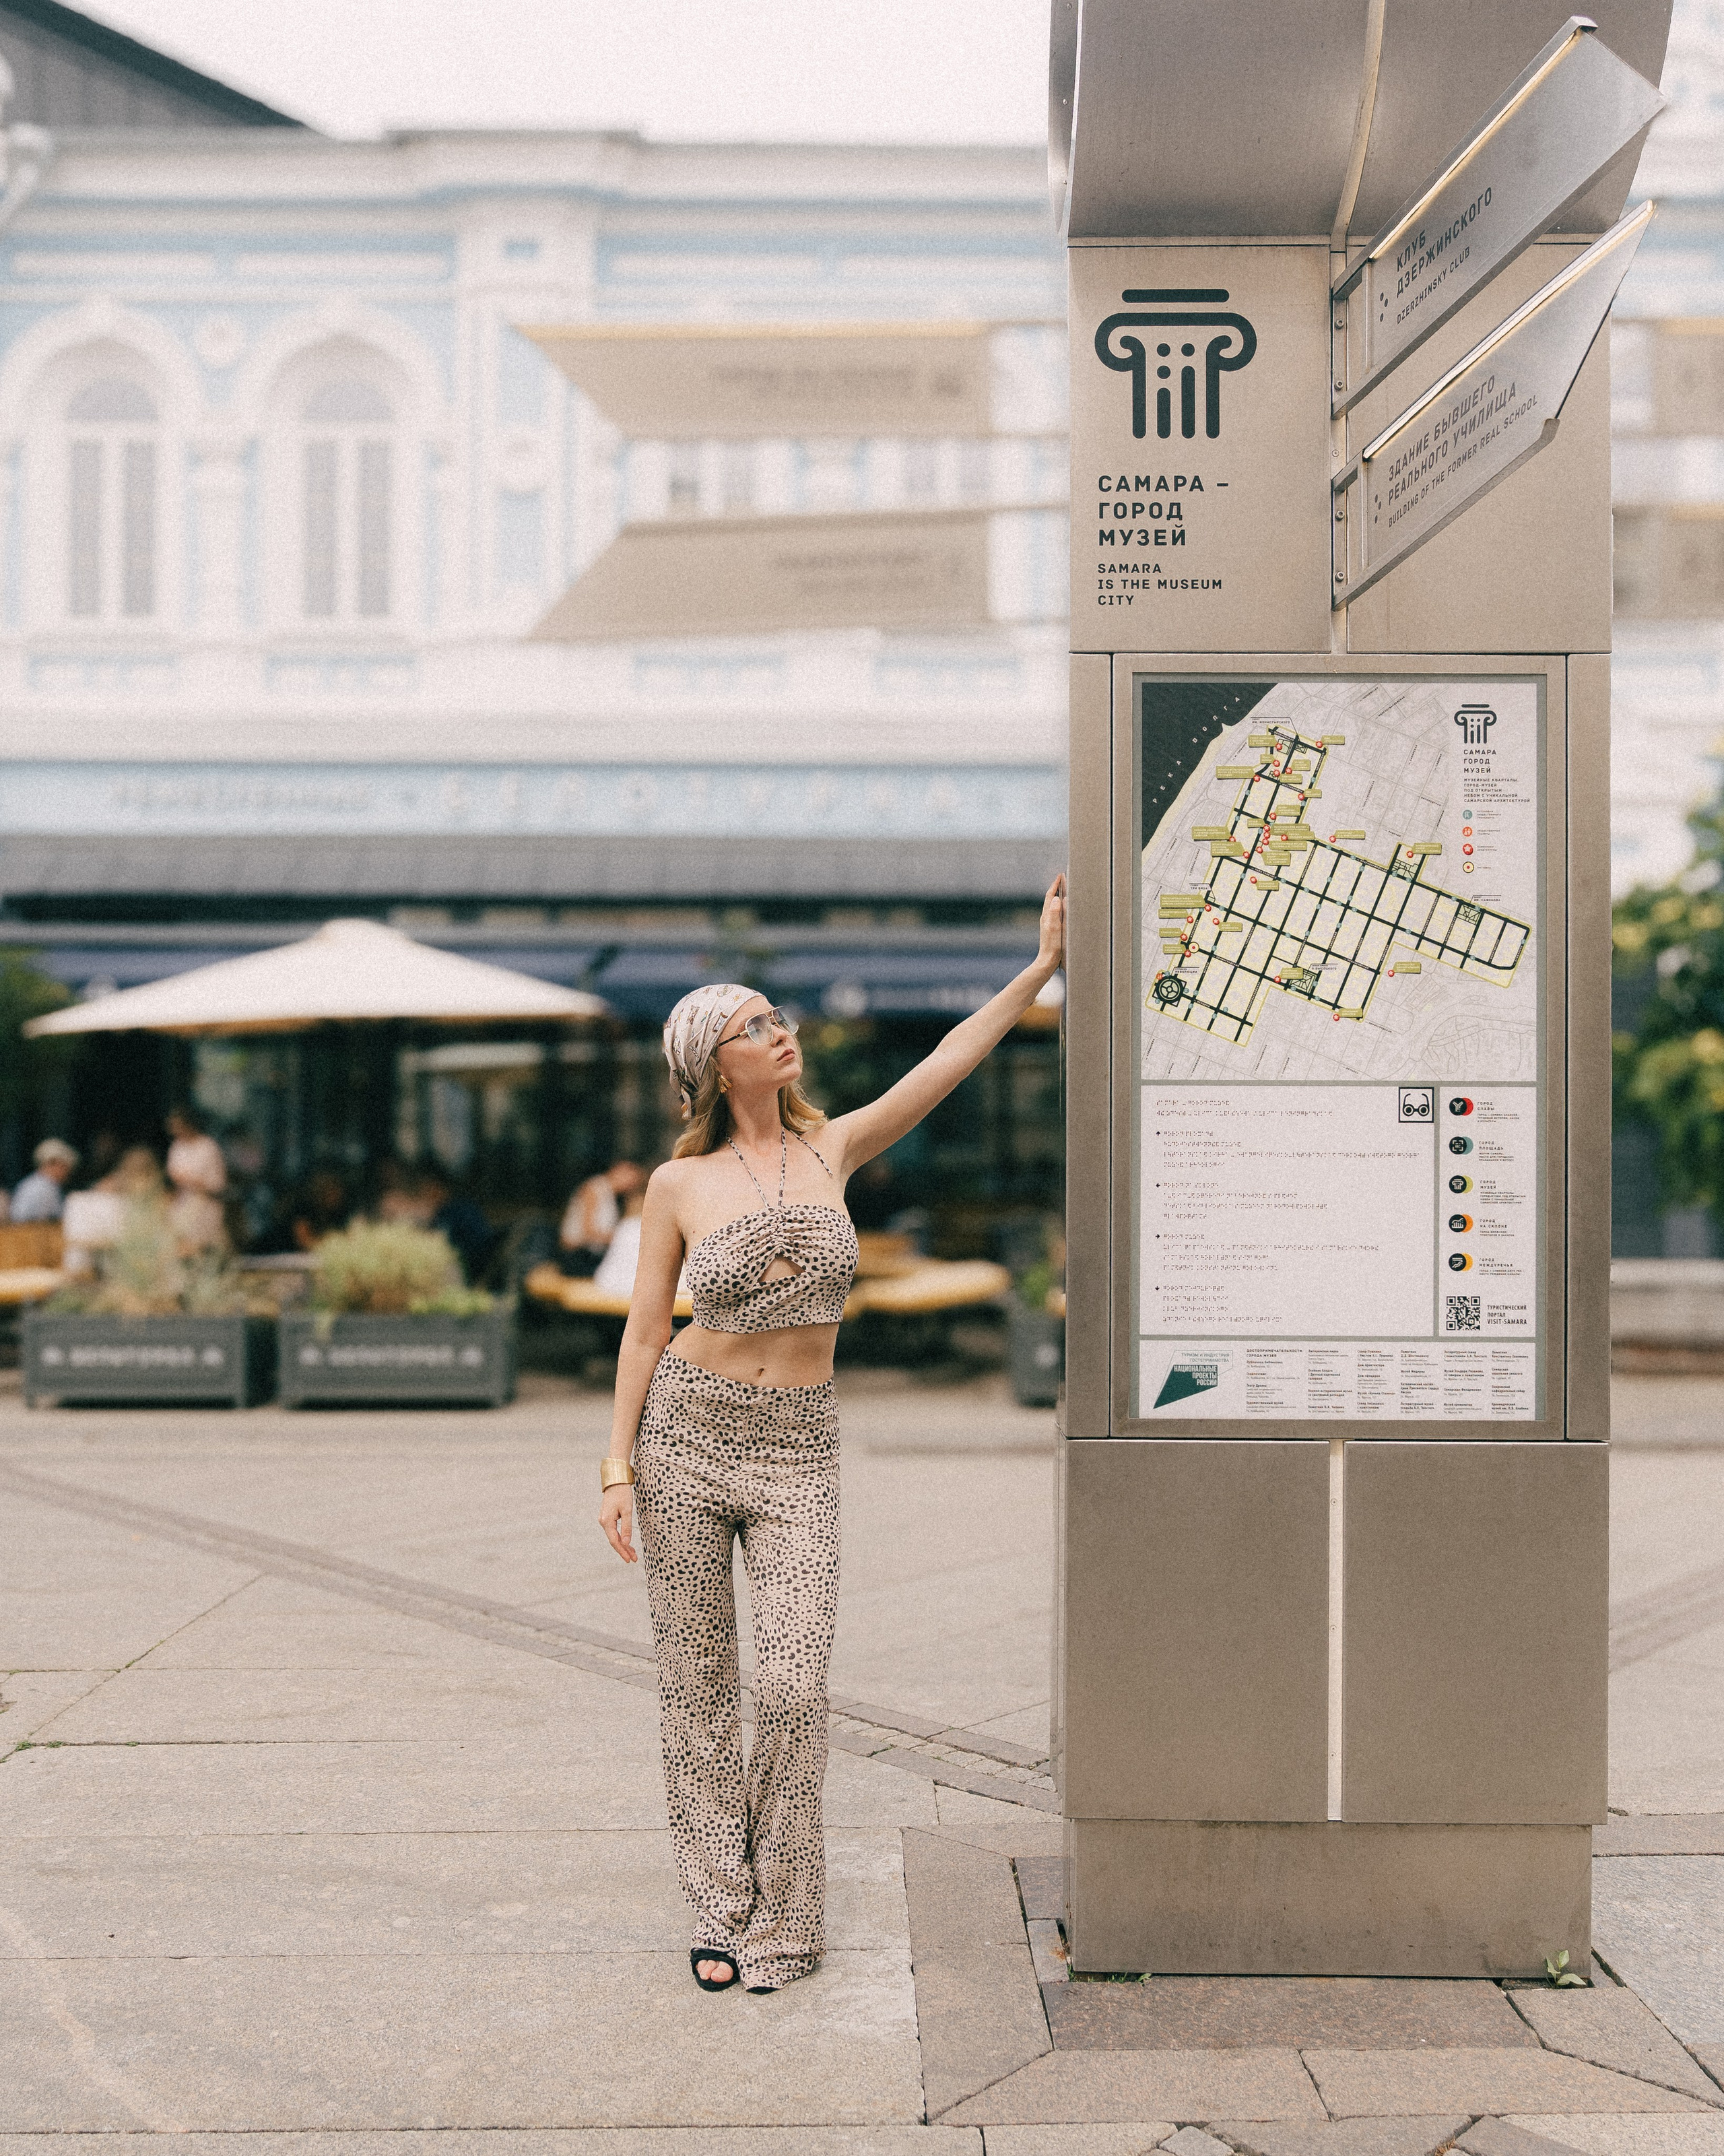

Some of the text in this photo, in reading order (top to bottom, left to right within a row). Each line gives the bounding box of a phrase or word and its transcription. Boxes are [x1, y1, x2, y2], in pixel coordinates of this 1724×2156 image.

[1396, 187, 1492, 298] ДЗЕРЖИНСКОГО
[1397, 230, 1426, 272] КЛУБ
[1397, 246, 1471, 325] DZERZHINSKY CLUB
[1388, 381, 1516, 505] РЕАЛЬНОГО УЧИЛИЩА
[1389, 374, 1495, 482] ЗДАНИЕ БЫВШЕГО
[1388, 395, 1537, 528] BUILDING OF THE FORMER REAL SCHOOL
[1098, 475, 1204, 492] САМАРА
[1098, 502, 1183, 521] ГОРОД
[1098, 524, 1186, 546] МУЗЕЙ
[1098, 563, 1162, 573] SAMARA
[1098, 579, 1222, 589] IS THE MUSEUM
[1098, 595, 1134, 605] CITY
